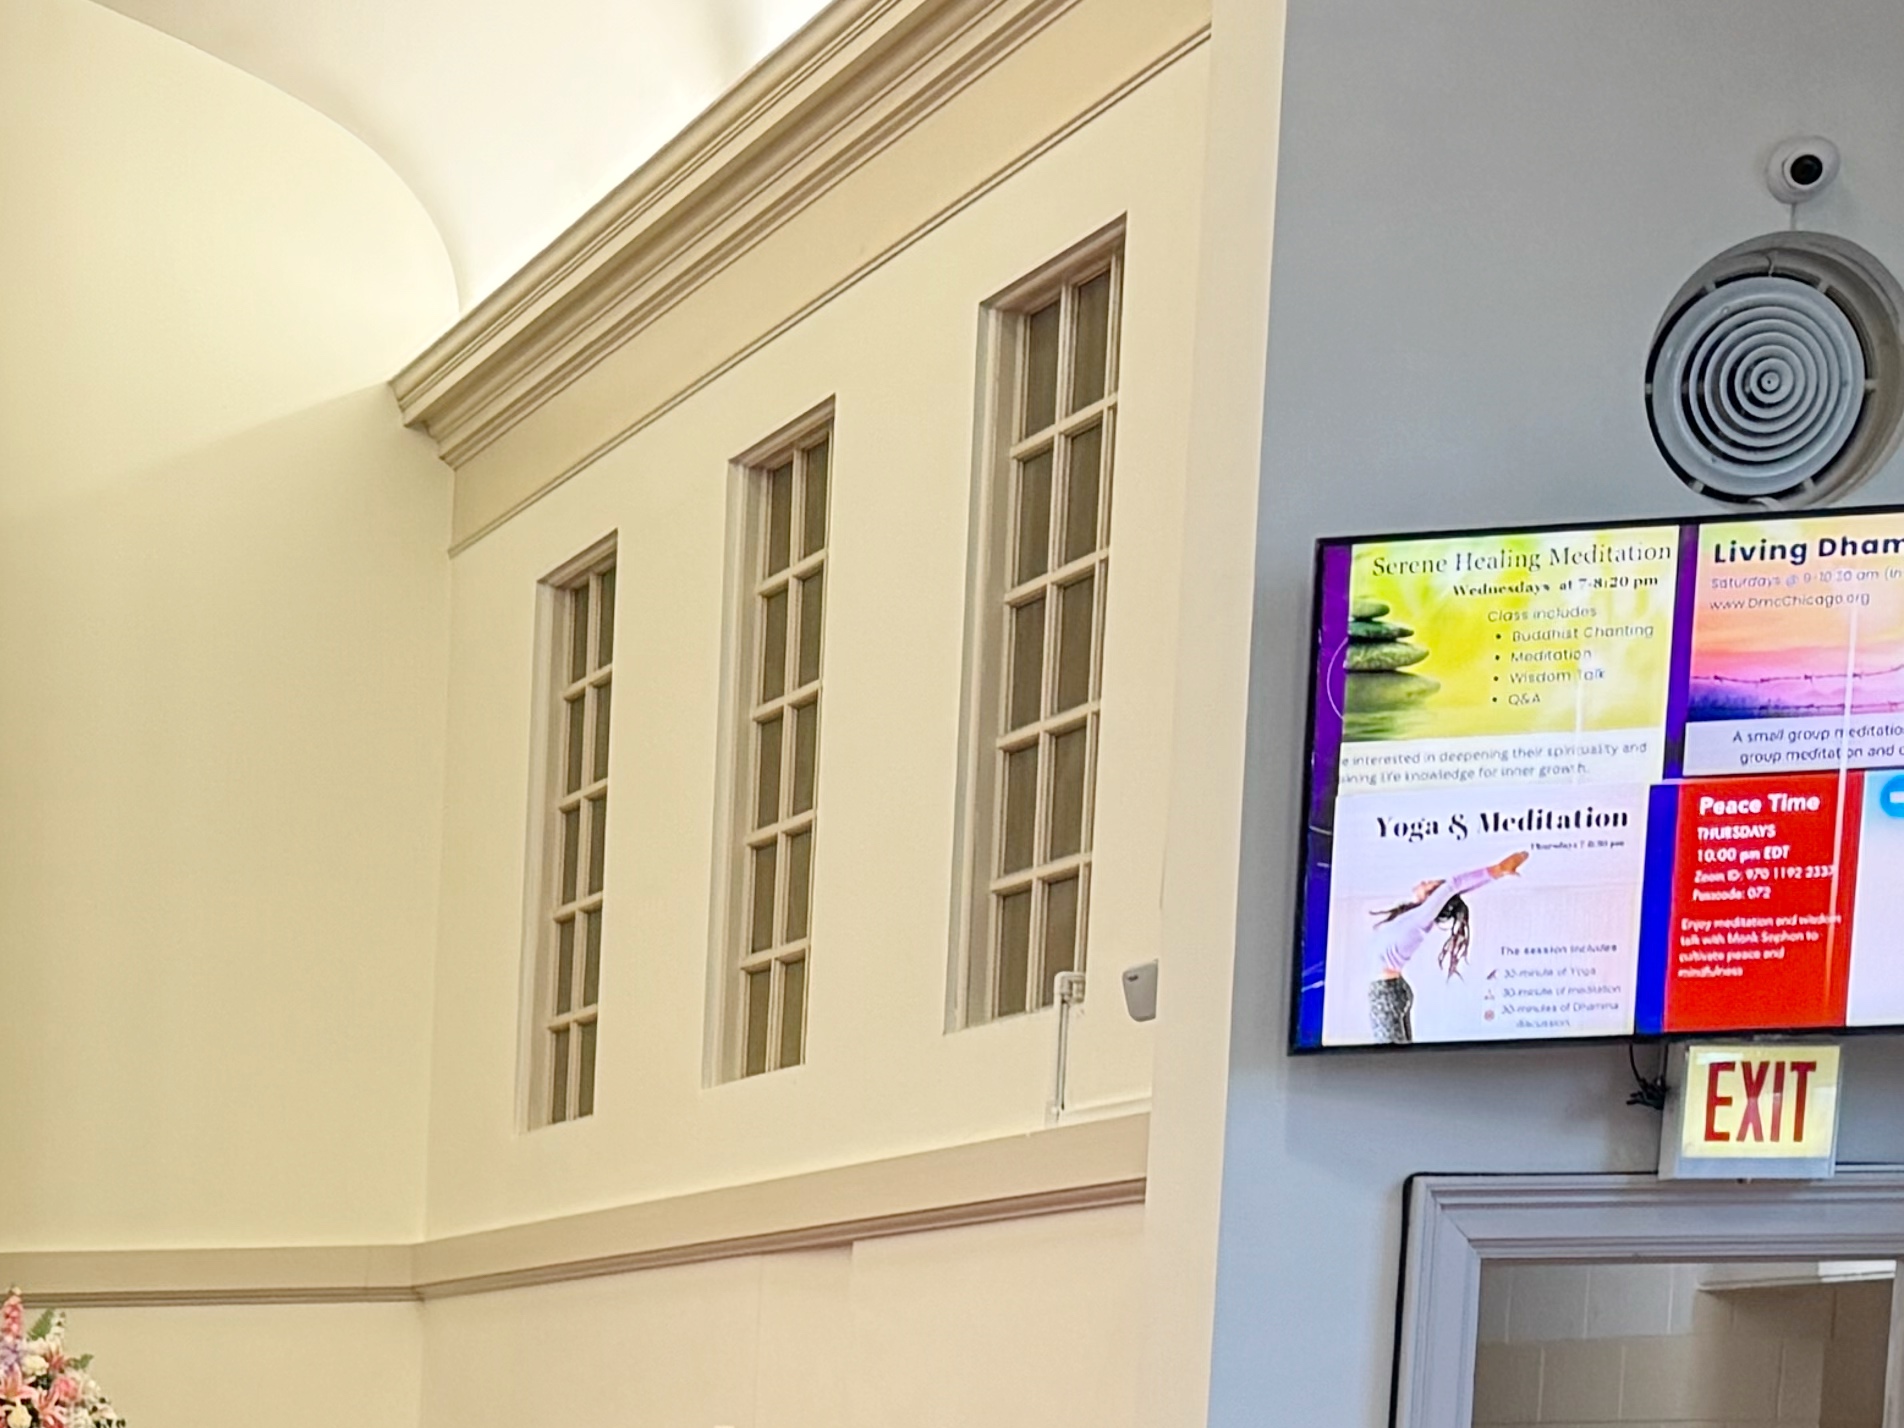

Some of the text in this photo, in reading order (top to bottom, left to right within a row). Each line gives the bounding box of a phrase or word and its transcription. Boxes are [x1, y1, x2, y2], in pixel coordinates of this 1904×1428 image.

[1372, 542, 1672, 577] Serene Healing Meditation
[1714, 537, 1808, 566] Living
[1452, 580, 1551, 598] Wednesdays
[1558, 578, 1573, 591] at
[1633, 576, 1658, 589] pm
[1488, 608, 1529, 623] Class
[1512, 624, 1654, 643] Buddhist Chanting
[1510, 648, 1592, 664] Meditation
[1509, 670, 1571, 684] Wisdom
[1508, 693, 1541, 706] Q&A
[1733, 730, 1743, 744] A
[1747, 728, 1784, 743] small
[1788, 728, 1831, 744] group
[1353, 752, 1421, 766] interested
[1439, 747, 1509, 766] deepening
[1623, 741, 1647, 755] and
[1740, 750, 1782, 766] group
[1786, 746, 1863, 764] meditaton
[1867, 744, 1895, 758] and
[1478, 765, 1497, 779] for
[1699, 793, 1821, 816] Peace Time
[1377, 817, 1440, 843] Yoga
[1478, 806, 1628, 834] Meditation
[1697, 823, 1777, 841] THURSDAYS
[1763, 844, 1791, 860] EDT
[1703, 1059, 1818, 1143] EXIT
